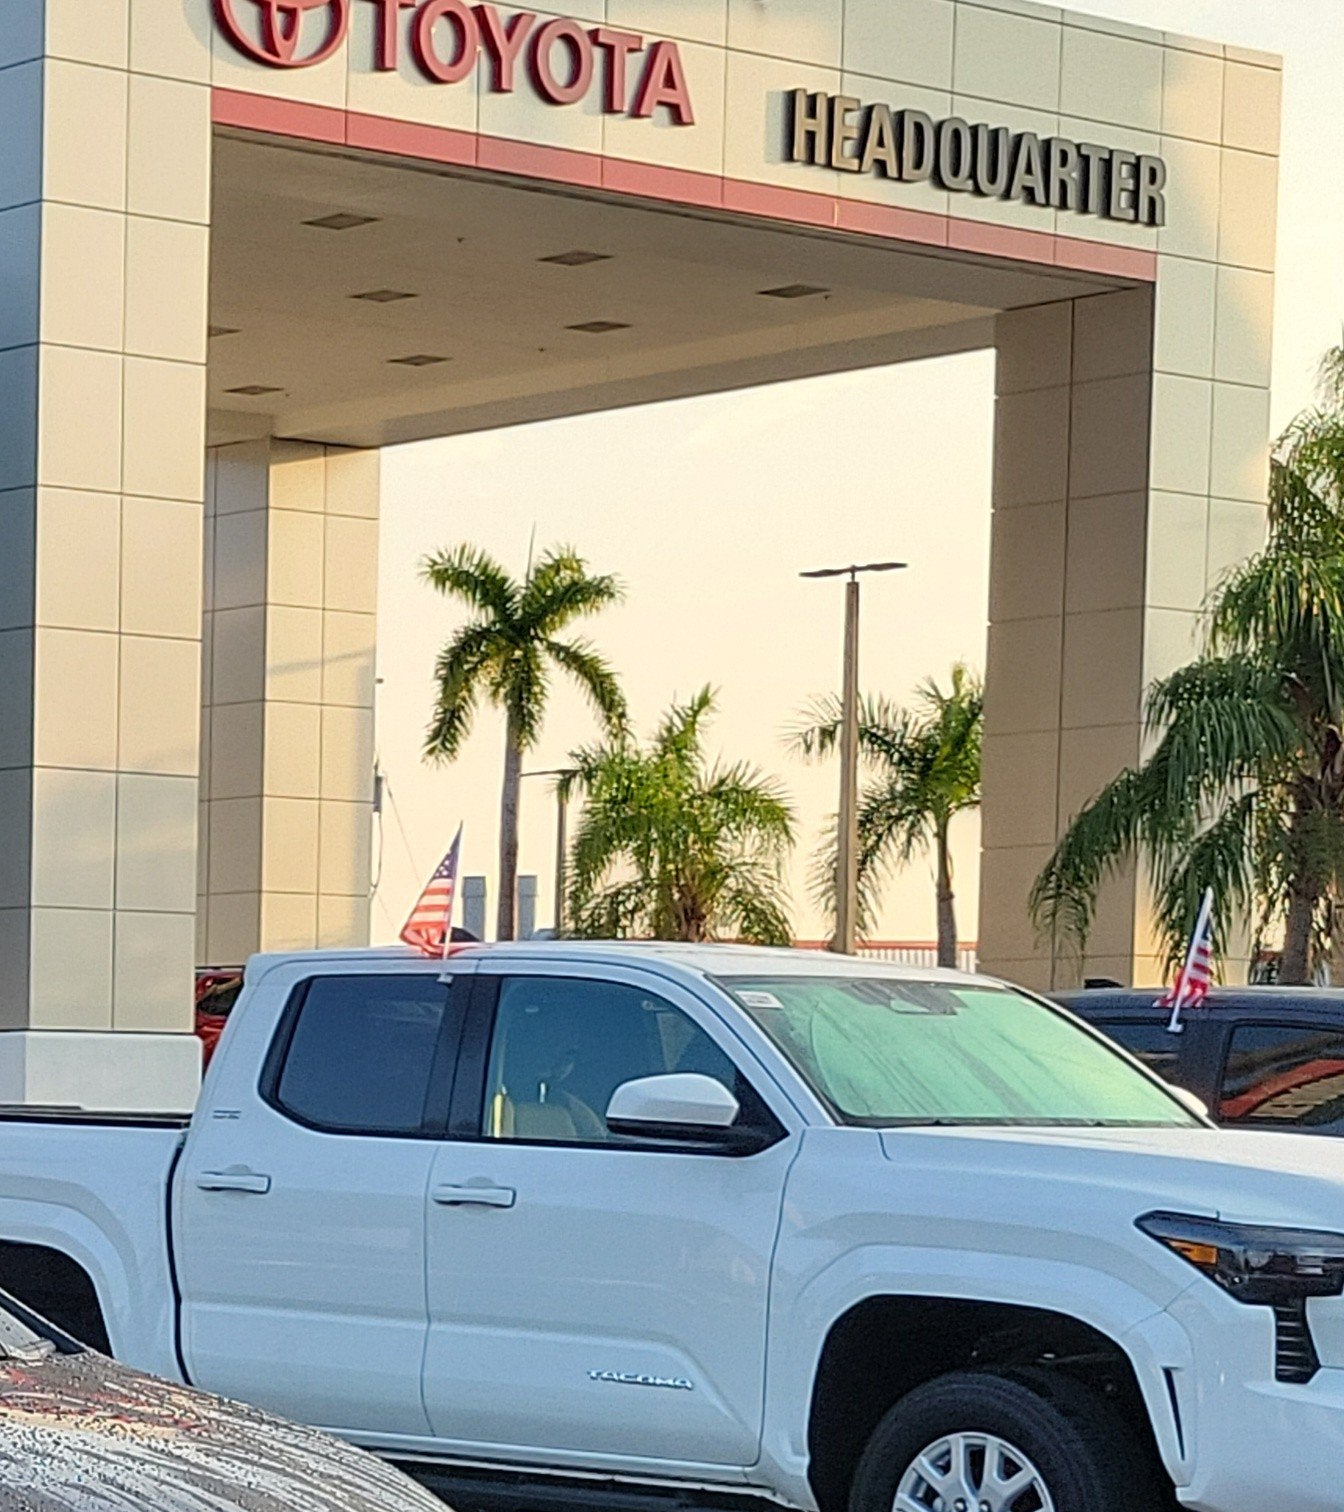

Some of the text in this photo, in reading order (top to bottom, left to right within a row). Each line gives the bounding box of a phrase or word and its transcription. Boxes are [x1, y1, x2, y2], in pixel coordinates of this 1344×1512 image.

[374, 0, 695, 125] TOYOTA
[789, 87, 1167, 227] HEADQUARTER
[587, 1369, 694, 1391] TACOMA
